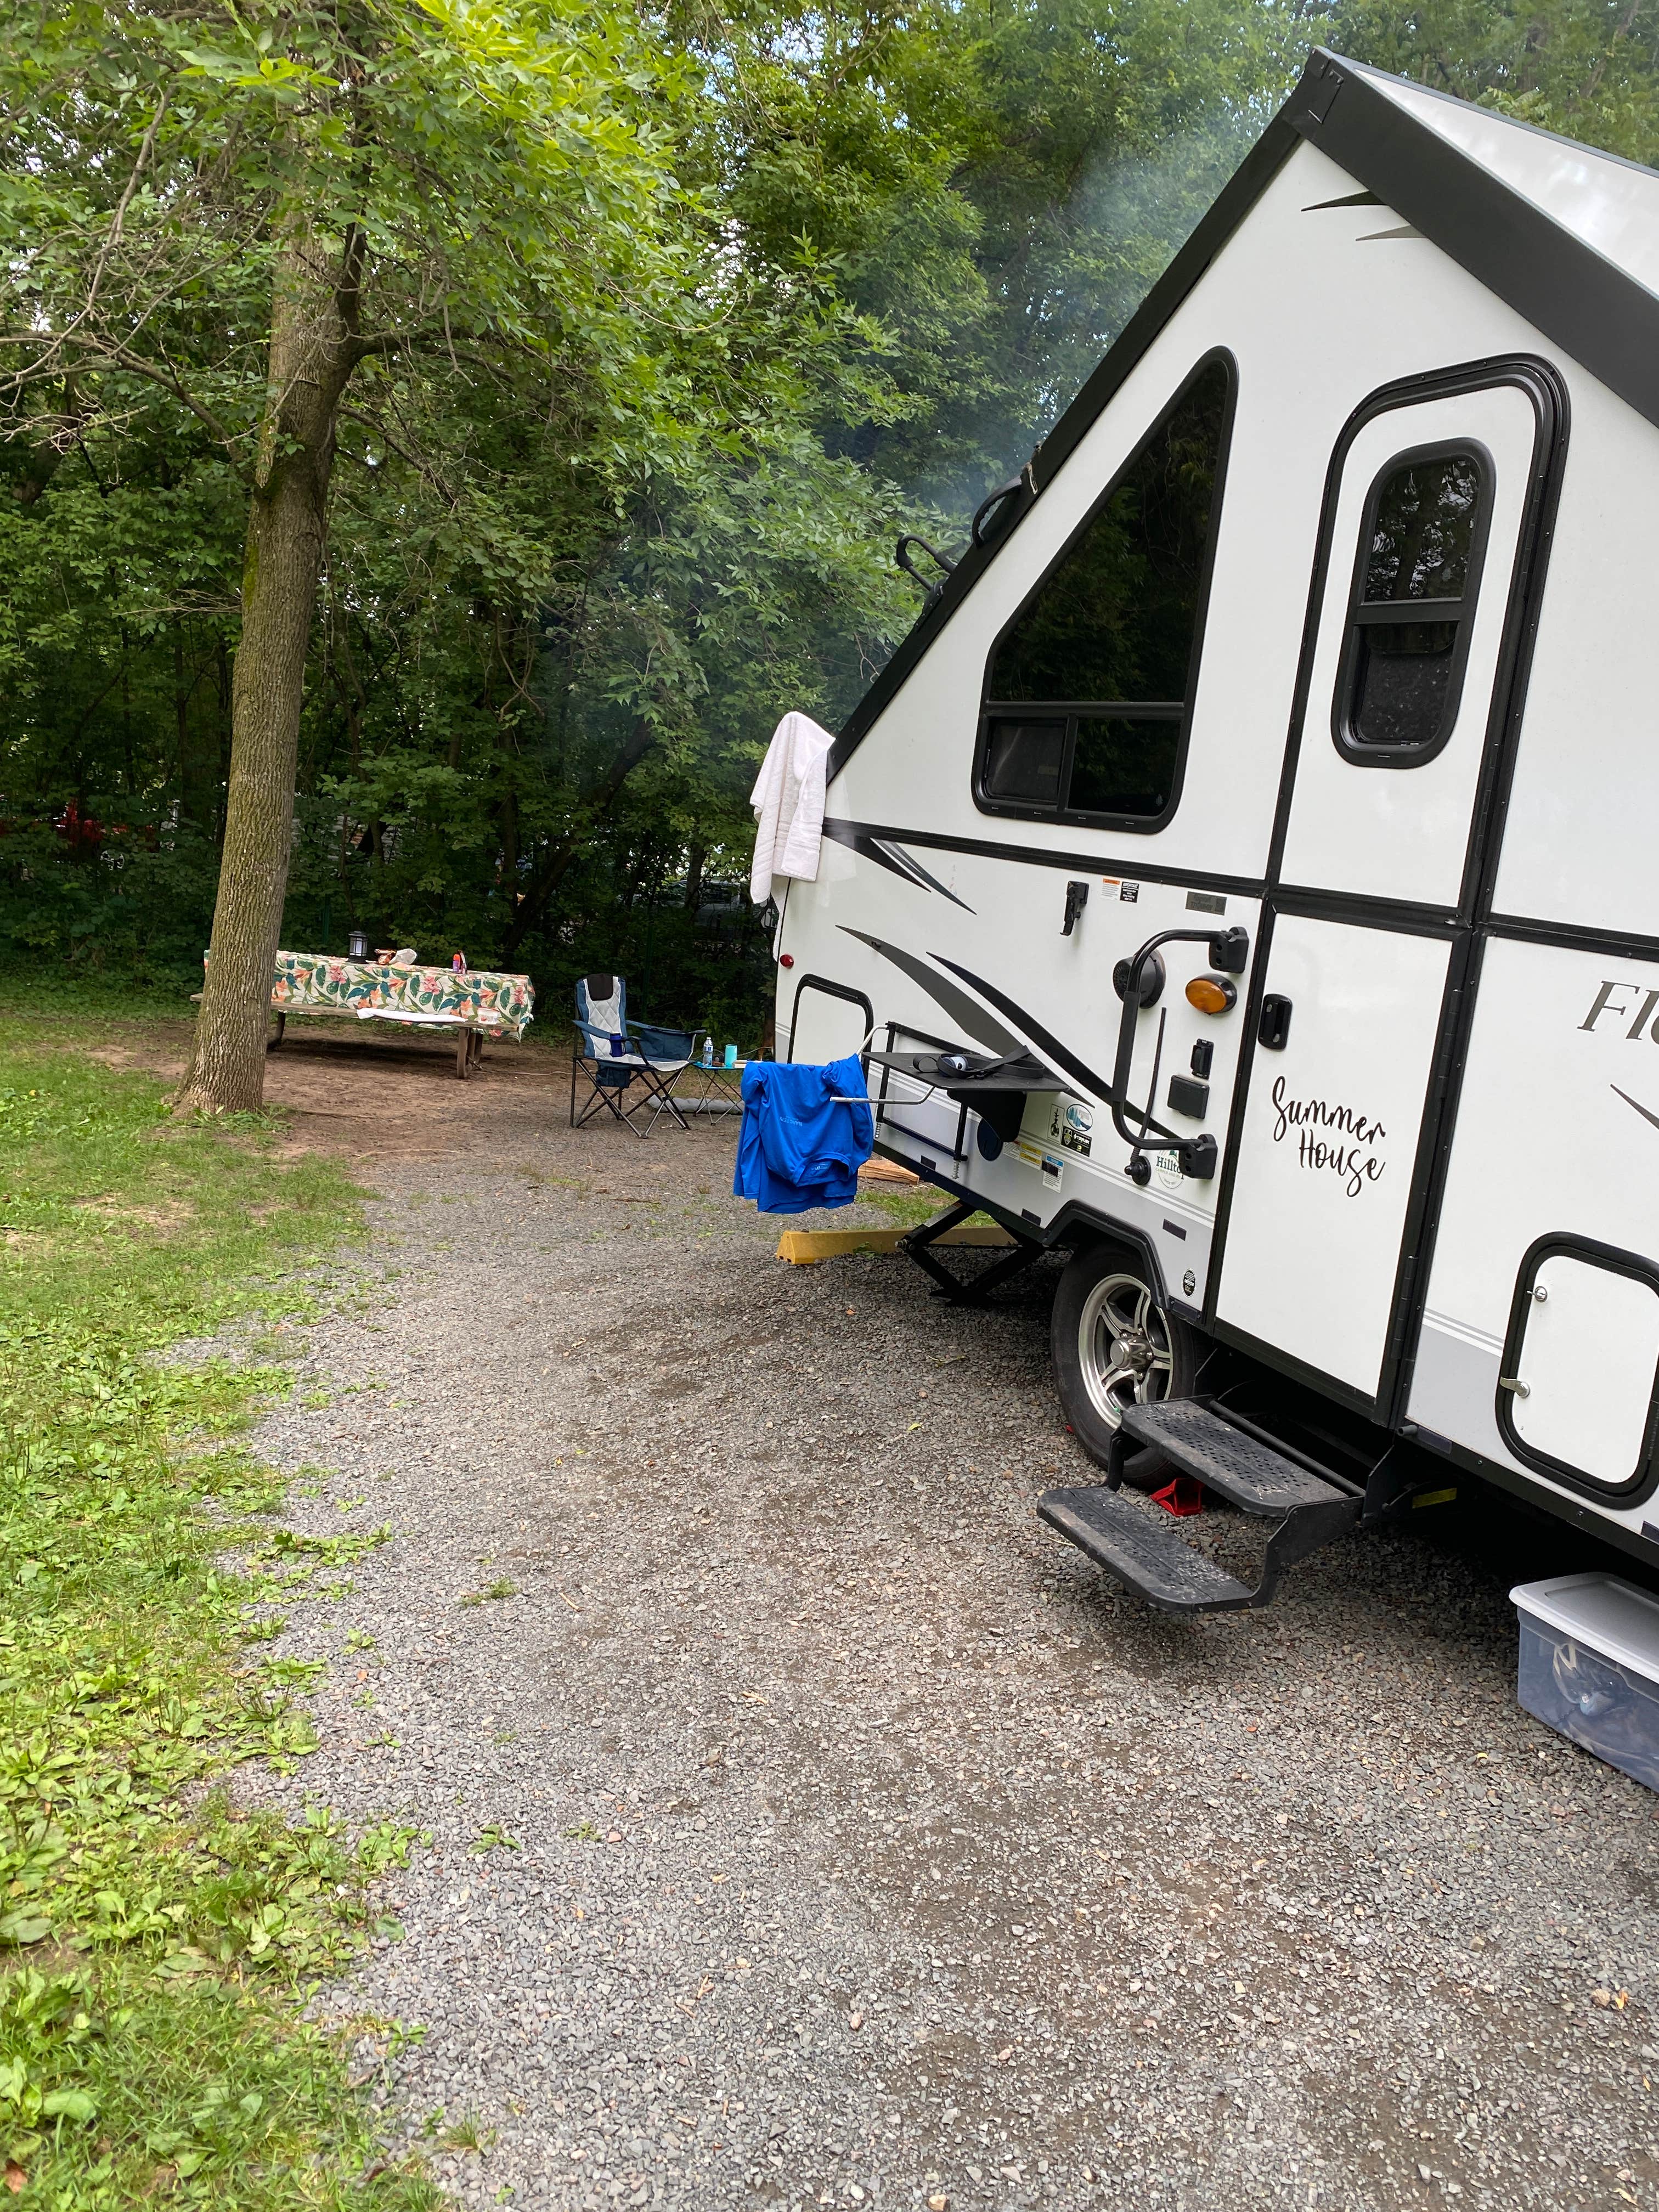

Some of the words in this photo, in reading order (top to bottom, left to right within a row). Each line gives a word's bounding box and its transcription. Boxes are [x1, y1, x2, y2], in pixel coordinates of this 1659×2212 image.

[1577, 980, 1659, 1045] Fl
[1272, 1076, 1386, 1145] Summer
[1299, 1128, 1386, 1197] House
